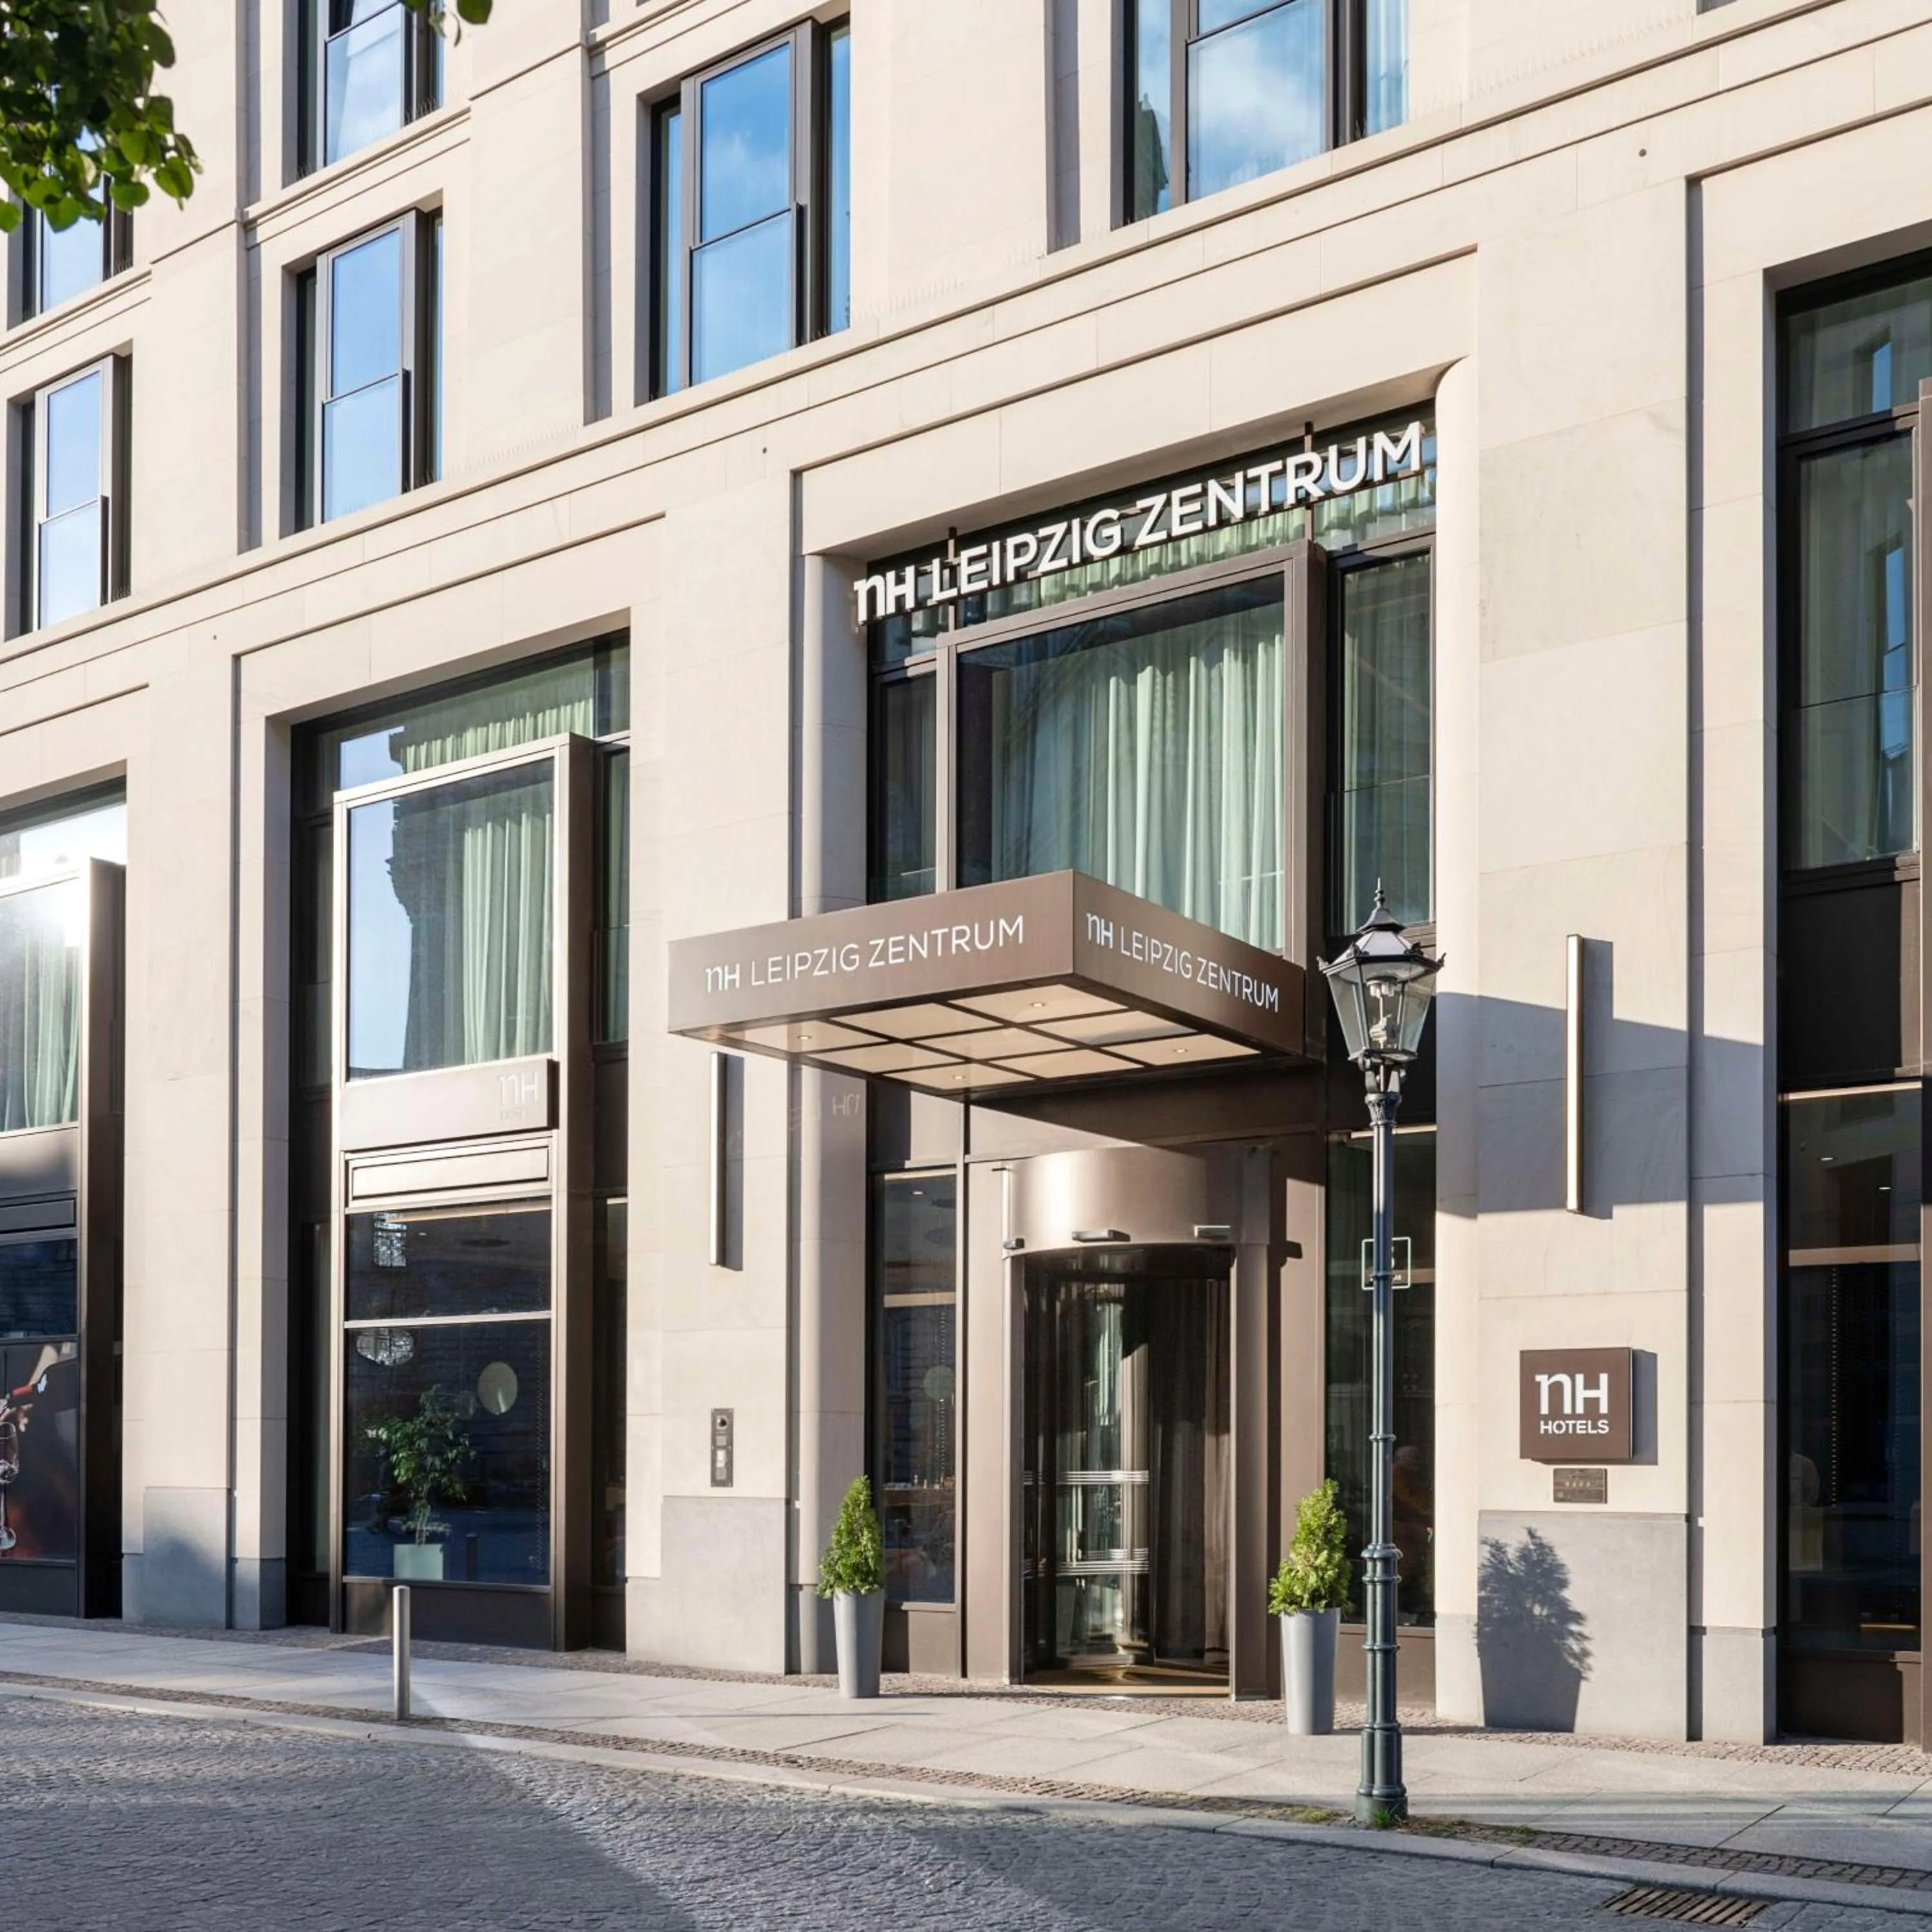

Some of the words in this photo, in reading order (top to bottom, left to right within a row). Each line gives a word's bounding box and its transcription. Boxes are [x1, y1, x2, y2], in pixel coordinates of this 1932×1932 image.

[853, 565, 915, 625] nH
[932, 508, 1122, 603] LEIPZIG
[1134, 421, 1425, 549] ZENTRUM
[705, 963, 740, 993] nH
[751, 943, 860, 987] LEIPZIG
[867, 914, 1024, 968] ZENTRUM
[1086, 912, 1113, 949] nH
[1120, 926, 1193, 979] LEIPZIG
[1196, 957, 1279, 1014] ZENTRUM
[1535, 1372, 1609, 1415] nH
[1539, 1419, 1609, 1434] HOTELS
